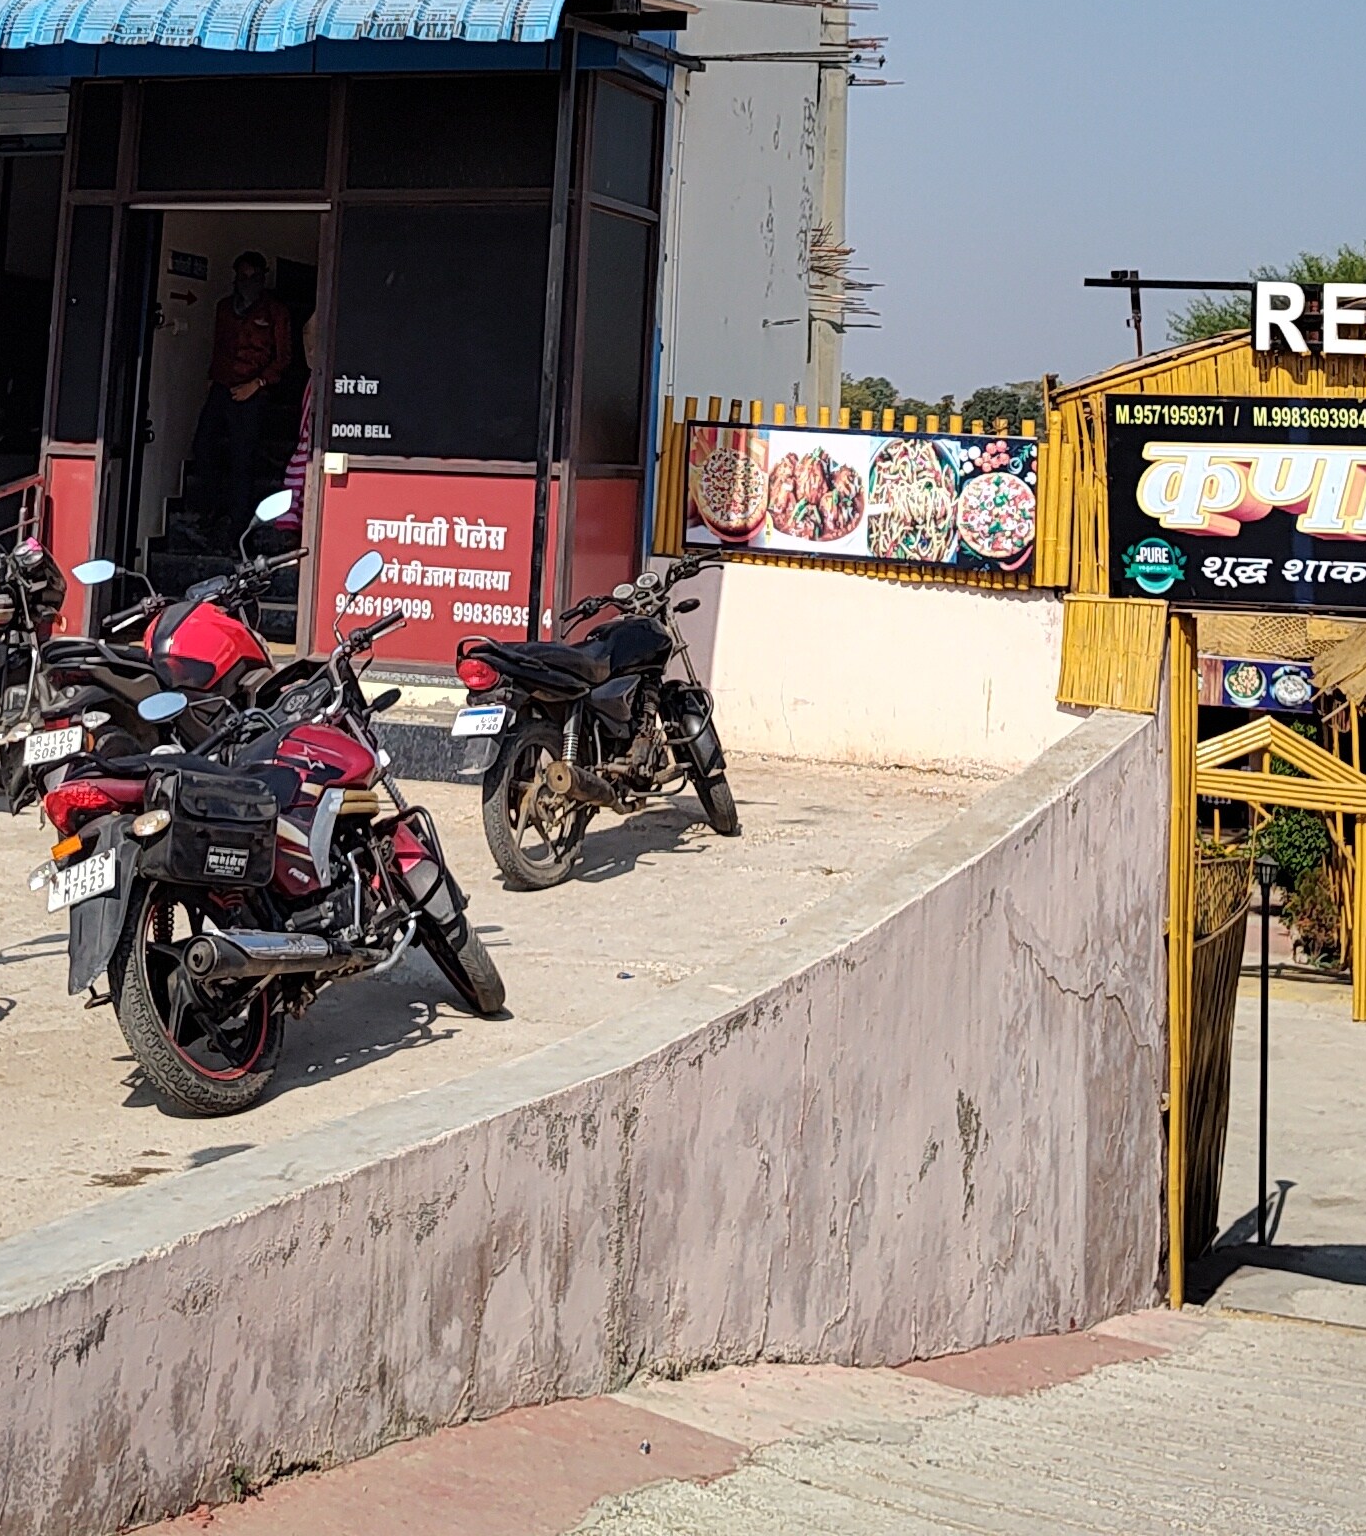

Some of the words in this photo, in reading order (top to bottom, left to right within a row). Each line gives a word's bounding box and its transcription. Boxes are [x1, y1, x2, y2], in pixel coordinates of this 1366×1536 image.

[334, 374, 356, 394] डोर
[1115, 404, 1225, 425] M.9571959371
[332, 423, 362, 438] DOOR
[364, 424, 392, 439] BELL
[366, 514, 450, 547] कर्णावती
[453, 516, 508, 551] पैलेस
[1139, 546, 1169, 563] PURE
[402, 560, 423, 585] की
[458, 568, 511, 591] व्यवस्था
[453, 601, 553, 629] 998369394
[64, 872, 105, 903] M7523
